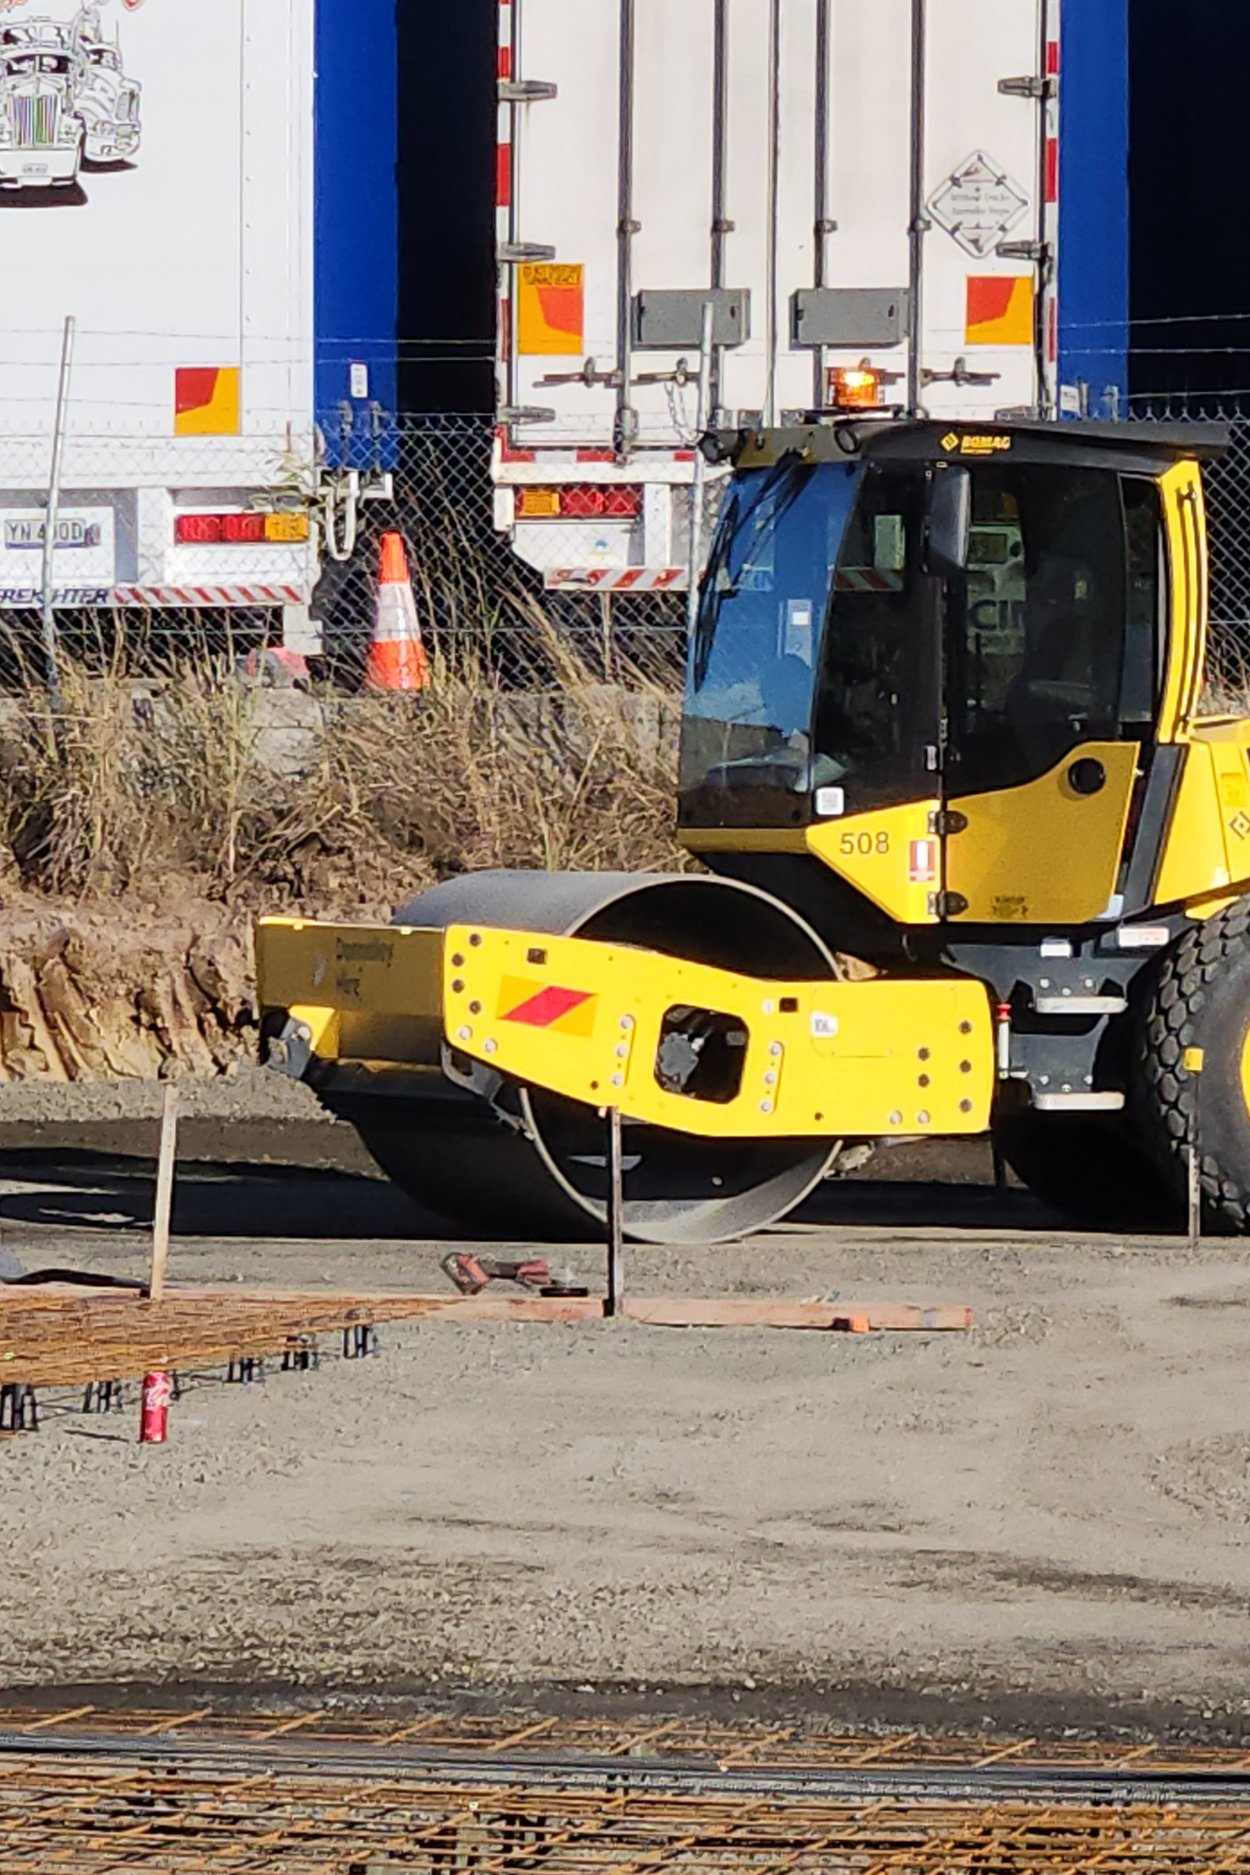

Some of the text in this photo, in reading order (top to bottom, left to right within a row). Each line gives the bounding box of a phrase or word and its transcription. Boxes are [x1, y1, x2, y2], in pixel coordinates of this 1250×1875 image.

[961, 435, 1011, 450] BOMAG
[9, 521, 32, 541] YN
[839, 831, 890, 855] 508
